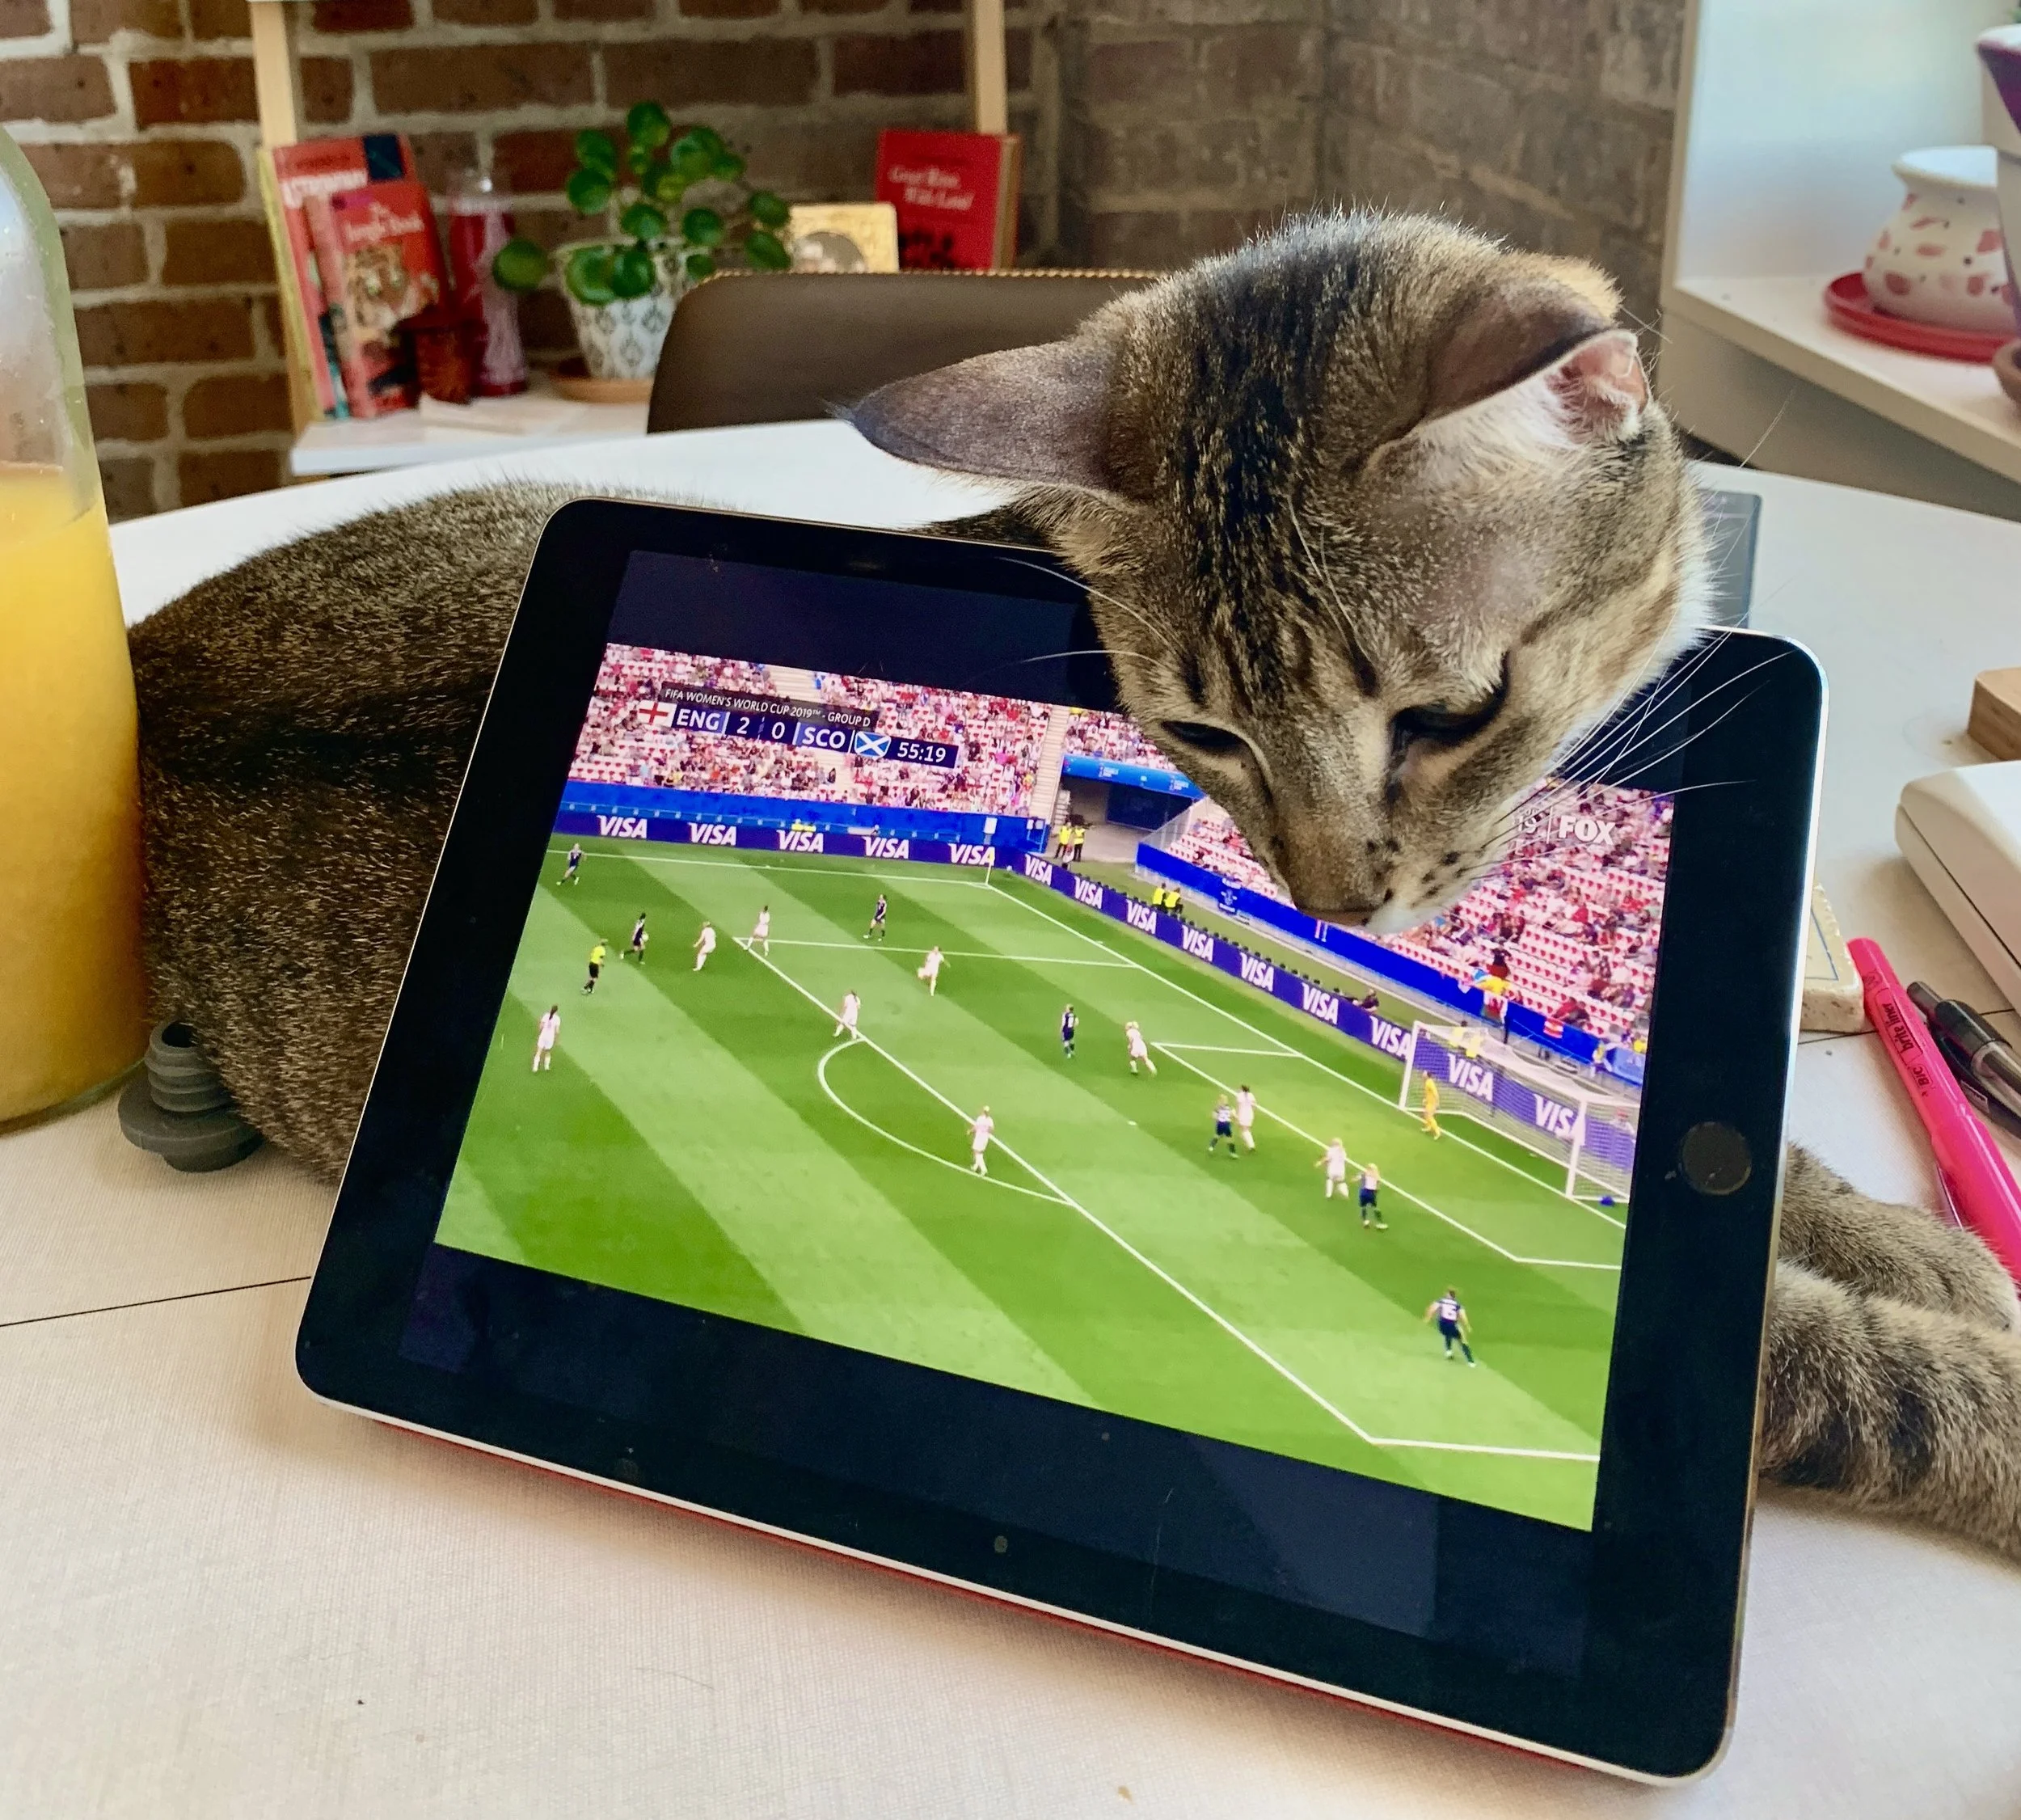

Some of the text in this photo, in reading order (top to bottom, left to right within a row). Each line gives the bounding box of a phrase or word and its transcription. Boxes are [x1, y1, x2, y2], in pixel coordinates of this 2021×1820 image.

[665, 688, 684, 700] FIFA
[686, 691, 732, 707] WOMEN'S
[732, 698, 768, 712] WORLD
[770, 703, 790, 715] CUP
[827, 712, 862, 726] GROUP
[863, 716, 871, 727] D
[676, 708, 946, 762] ENG 2 0 SCO 55:19
[597, 815, 995, 865] VISA VISA VISA VISA VISA
[1558, 814, 1616, 846] FOX
[1025, 854, 1053, 886] VISA
[1074, 876, 1103, 910] VISA
[1126, 899, 1157, 935] VISA
[1182, 925, 1213, 963] VISA
[1240, 952, 1274, 993] VISA
[1302, 982, 1340, 1026] VISA
[1369, 1015, 1411, 1062] VISA
[1447, 1053, 1494, 1102] VISA
[1882, 1003, 1930, 1086] BIC brite liner
